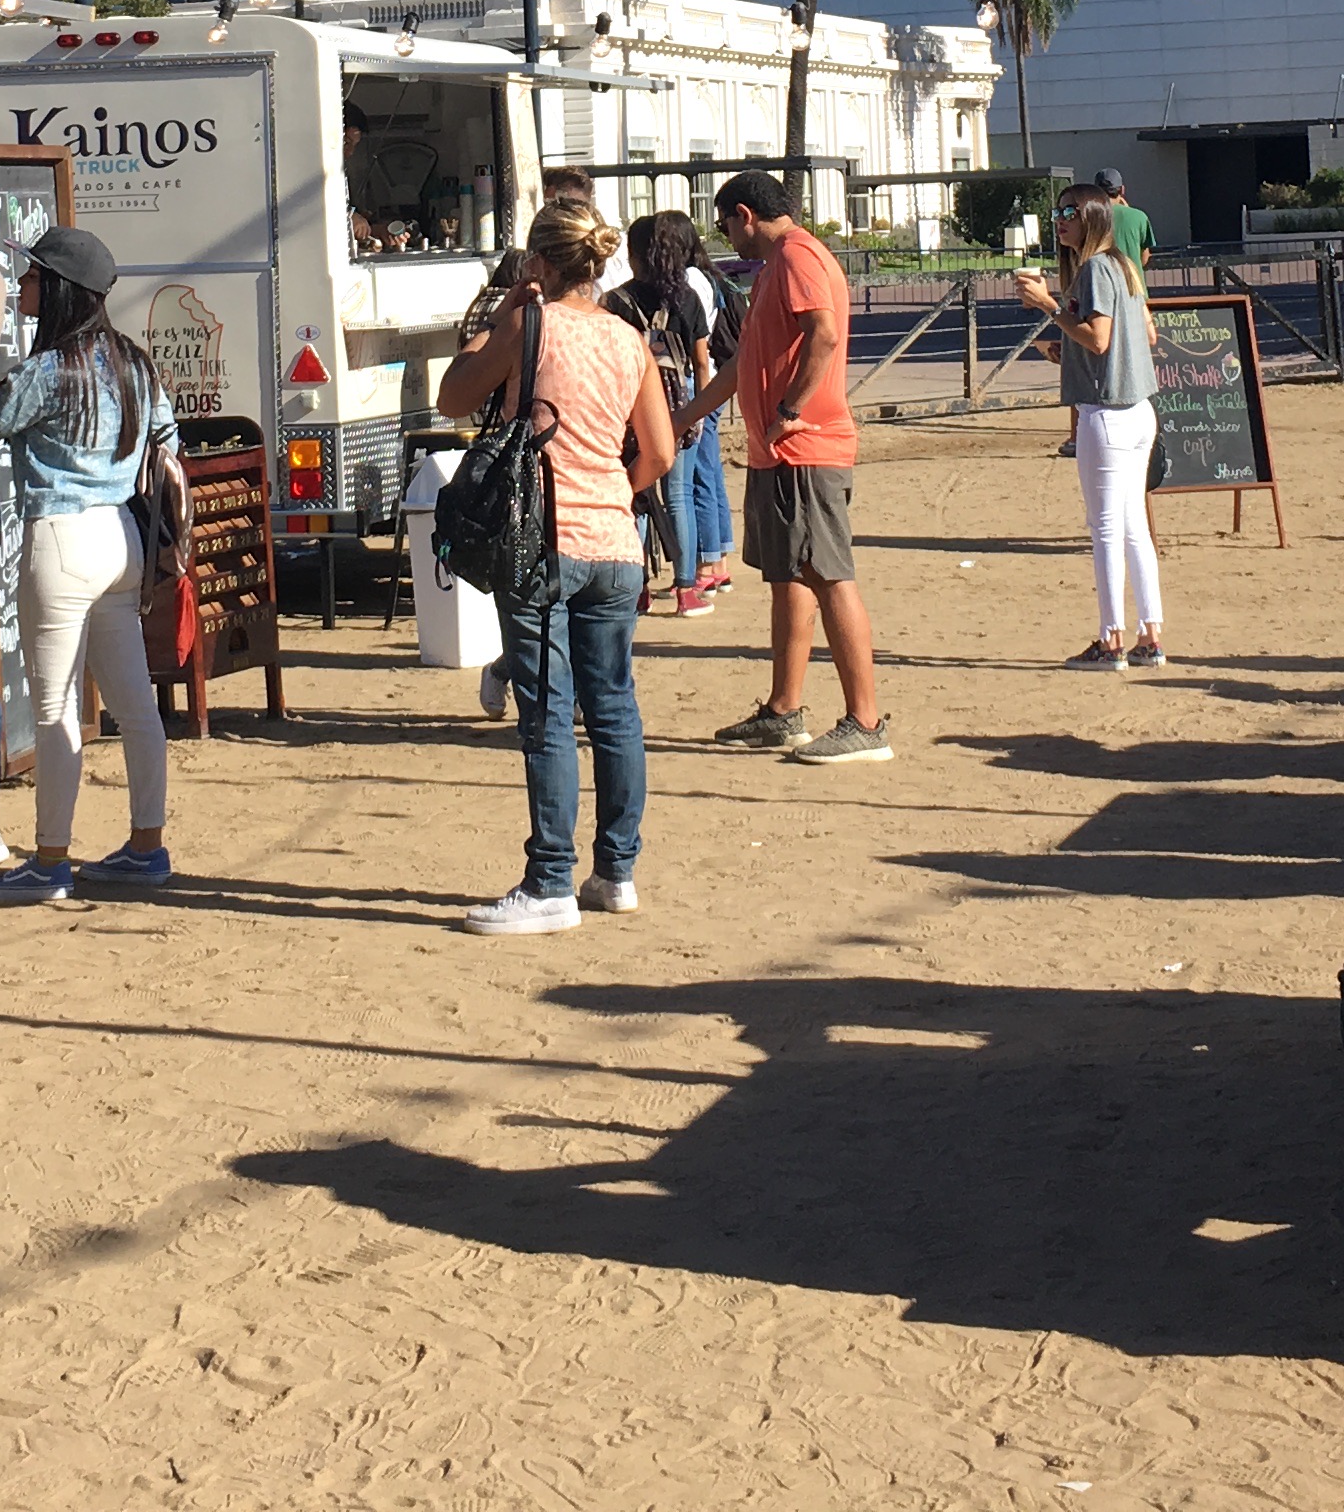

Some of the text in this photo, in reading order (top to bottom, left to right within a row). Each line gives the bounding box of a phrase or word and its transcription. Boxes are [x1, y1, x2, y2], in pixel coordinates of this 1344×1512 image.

[9, 106, 218, 169] Kainos
[124, 180, 132, 190] &
[142, 178, 182, 190] CAFÉ
[152, 344, 203, 360] FELIZ
[167, 392, 223, 414] ADOS
